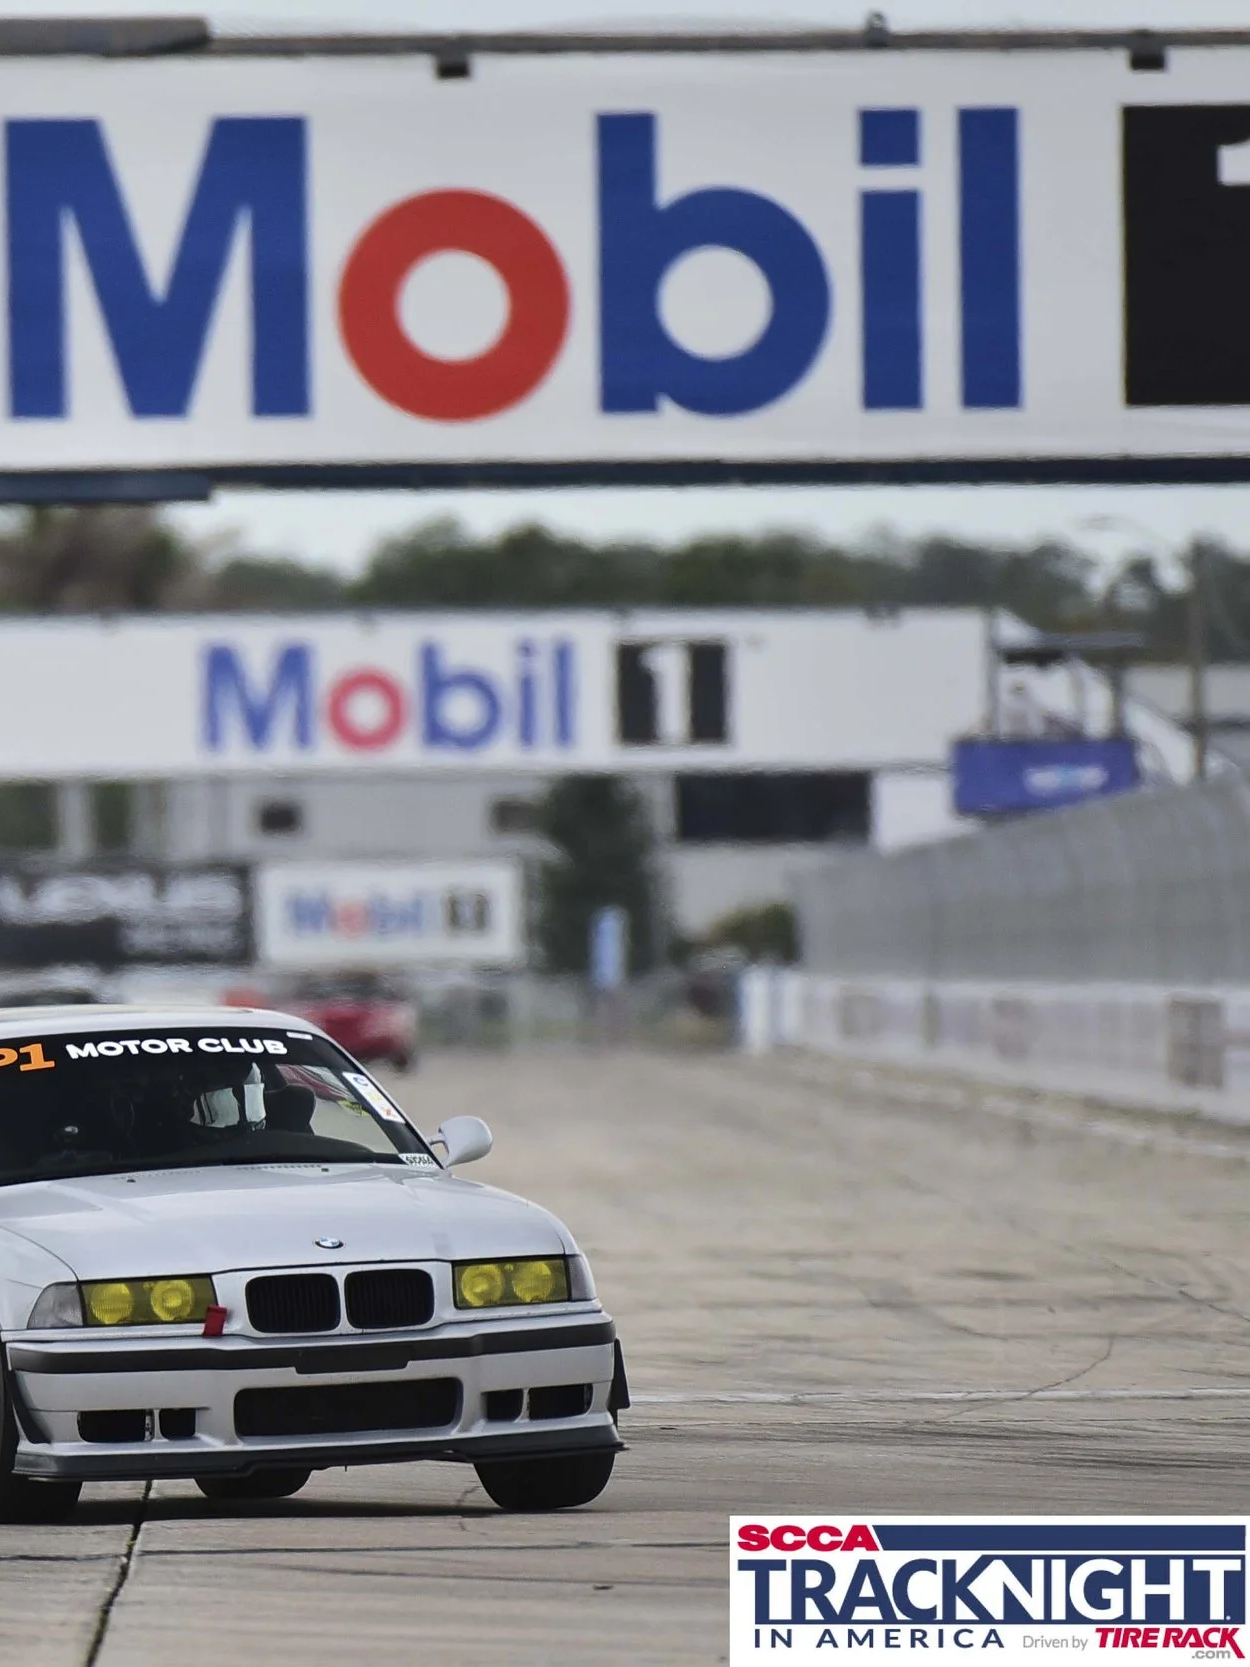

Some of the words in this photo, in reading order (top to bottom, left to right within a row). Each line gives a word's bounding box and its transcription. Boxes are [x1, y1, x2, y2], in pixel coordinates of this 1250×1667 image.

[2, 106, 1025, 424] Mobil
[201, 642, 576, 754] Mobil
[65, 1038, 193, 1059] MOTOR
[197, 1037, 288, 1055] CLUB
